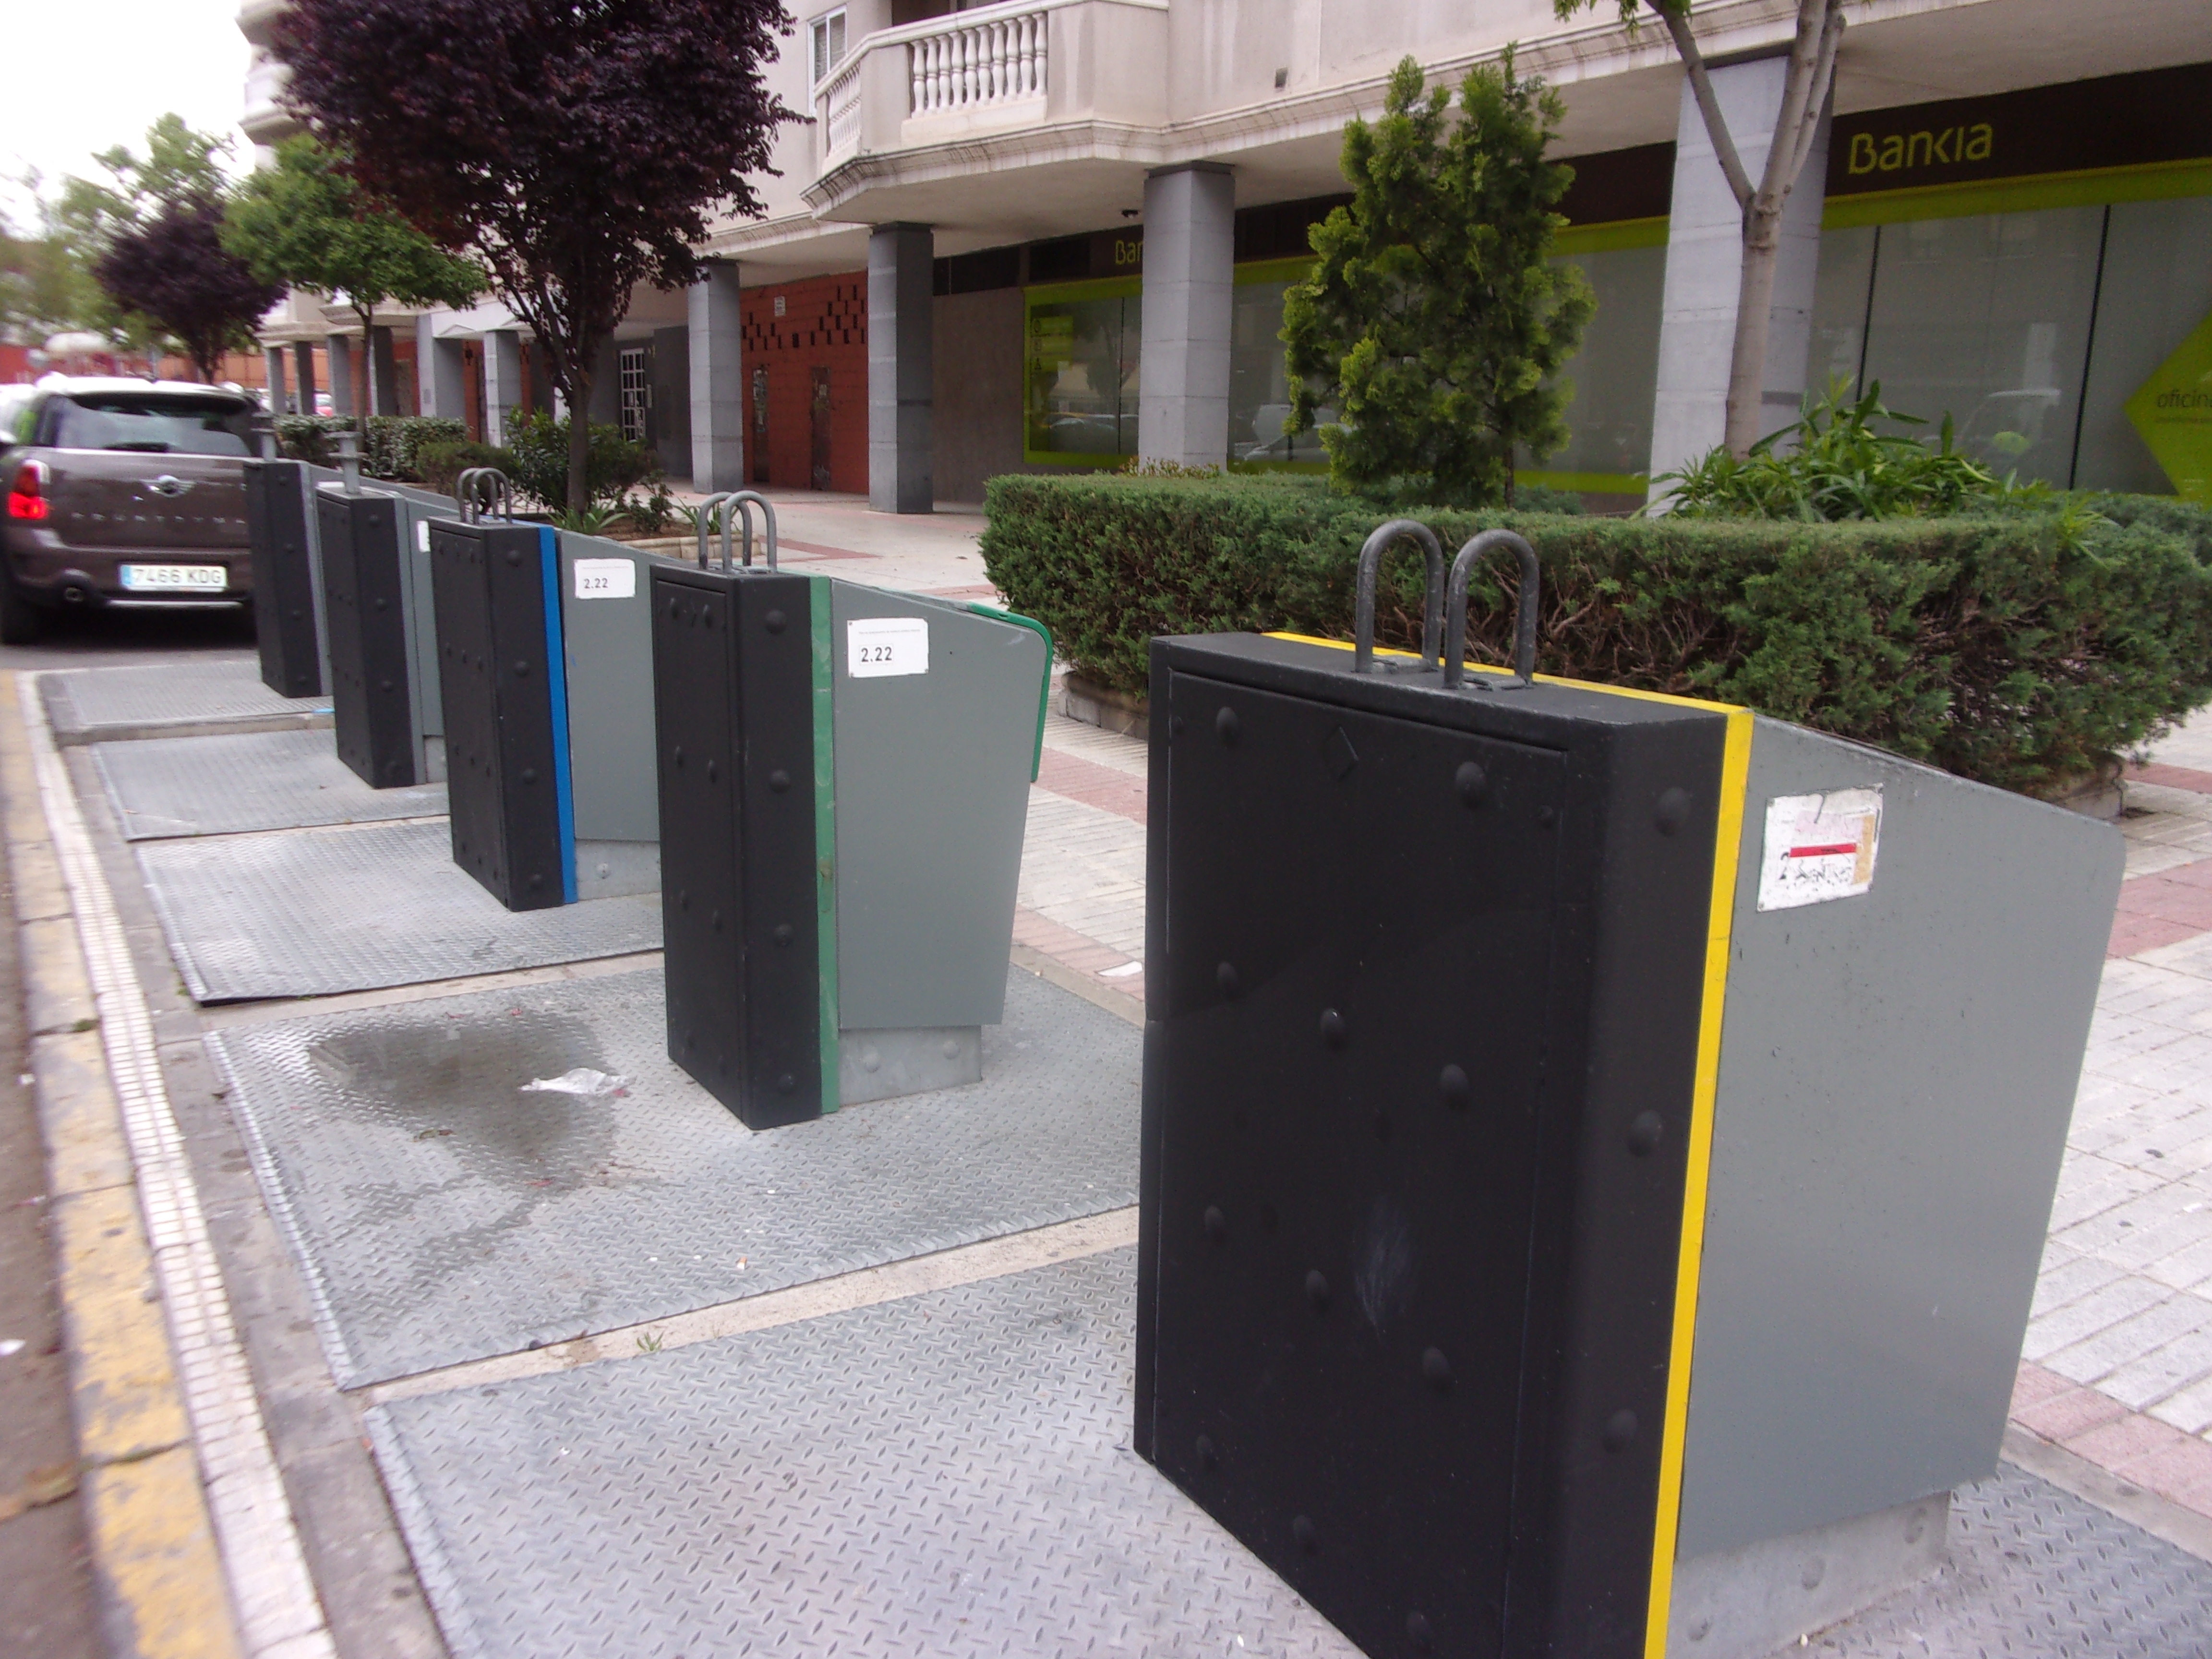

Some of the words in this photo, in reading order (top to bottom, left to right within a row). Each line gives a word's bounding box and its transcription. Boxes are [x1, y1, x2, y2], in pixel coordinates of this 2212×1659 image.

[1849, 122, 1993, 174] Bankia
[584, 577, 608, 589] 2.22
[861, 646, 892, 662] 2.22
